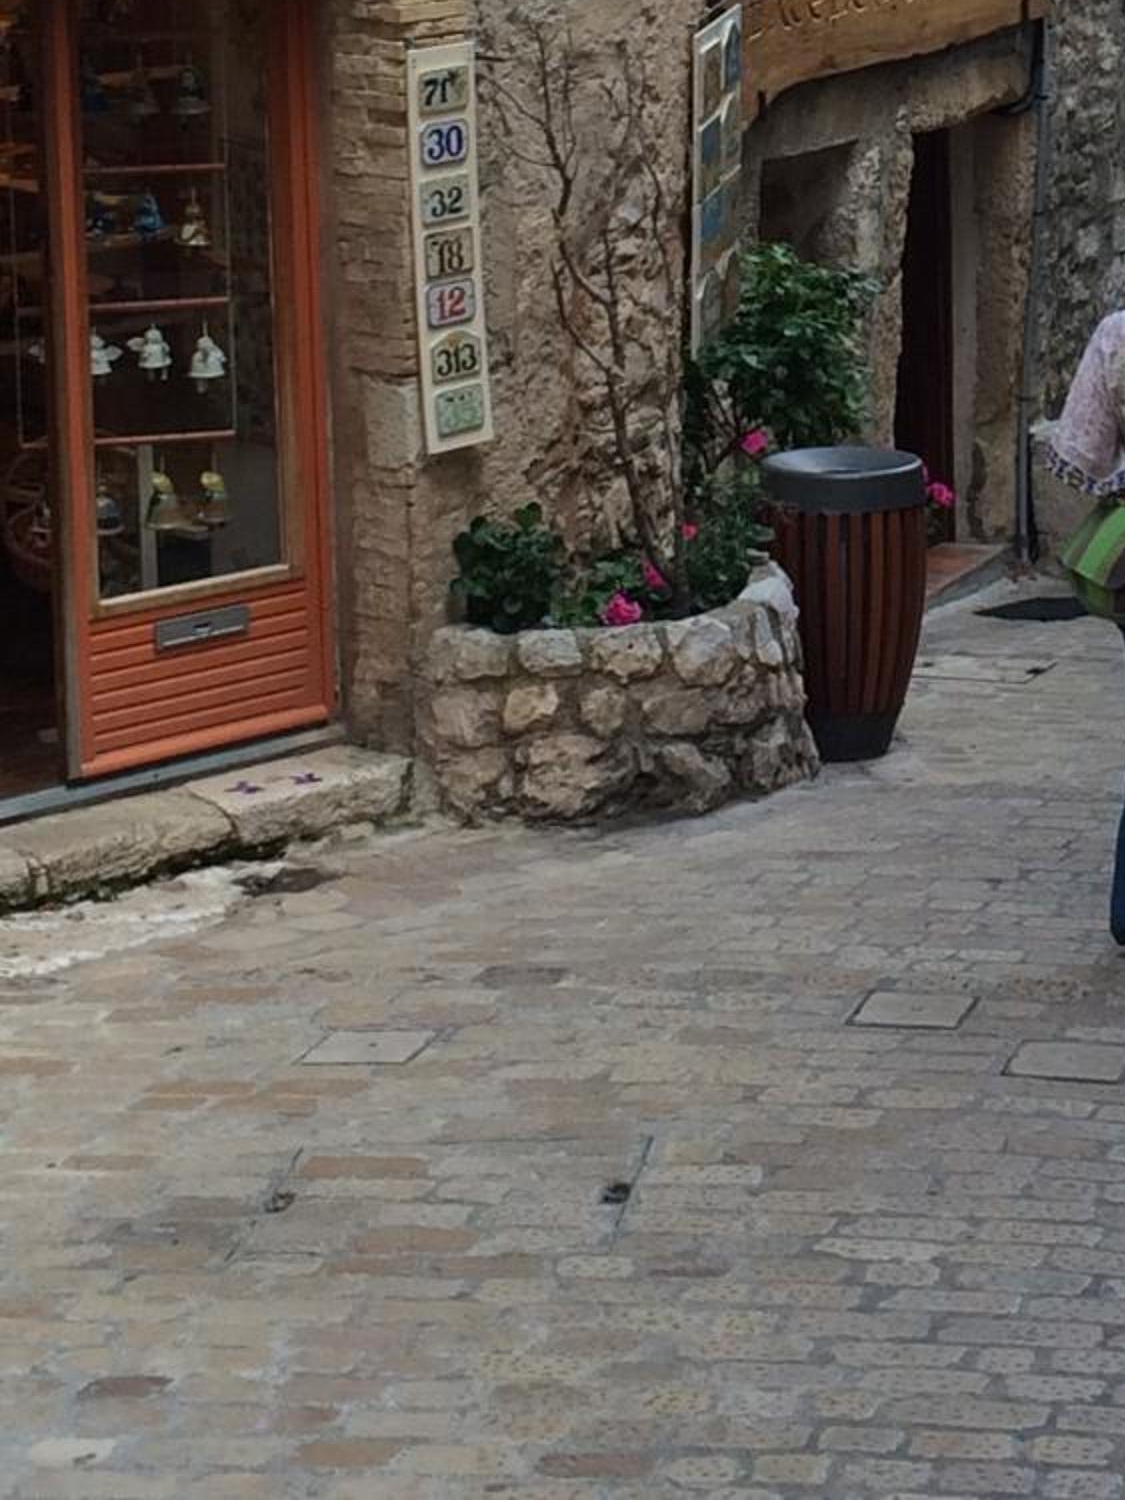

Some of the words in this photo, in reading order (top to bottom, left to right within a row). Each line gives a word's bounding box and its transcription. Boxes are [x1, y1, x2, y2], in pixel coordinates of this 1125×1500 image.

[426, 124, 464, 161] 30
[430, 186, 463, 218] 32
[437, 286, 466, 322] 12
[437, 343, 477, 377] 313
